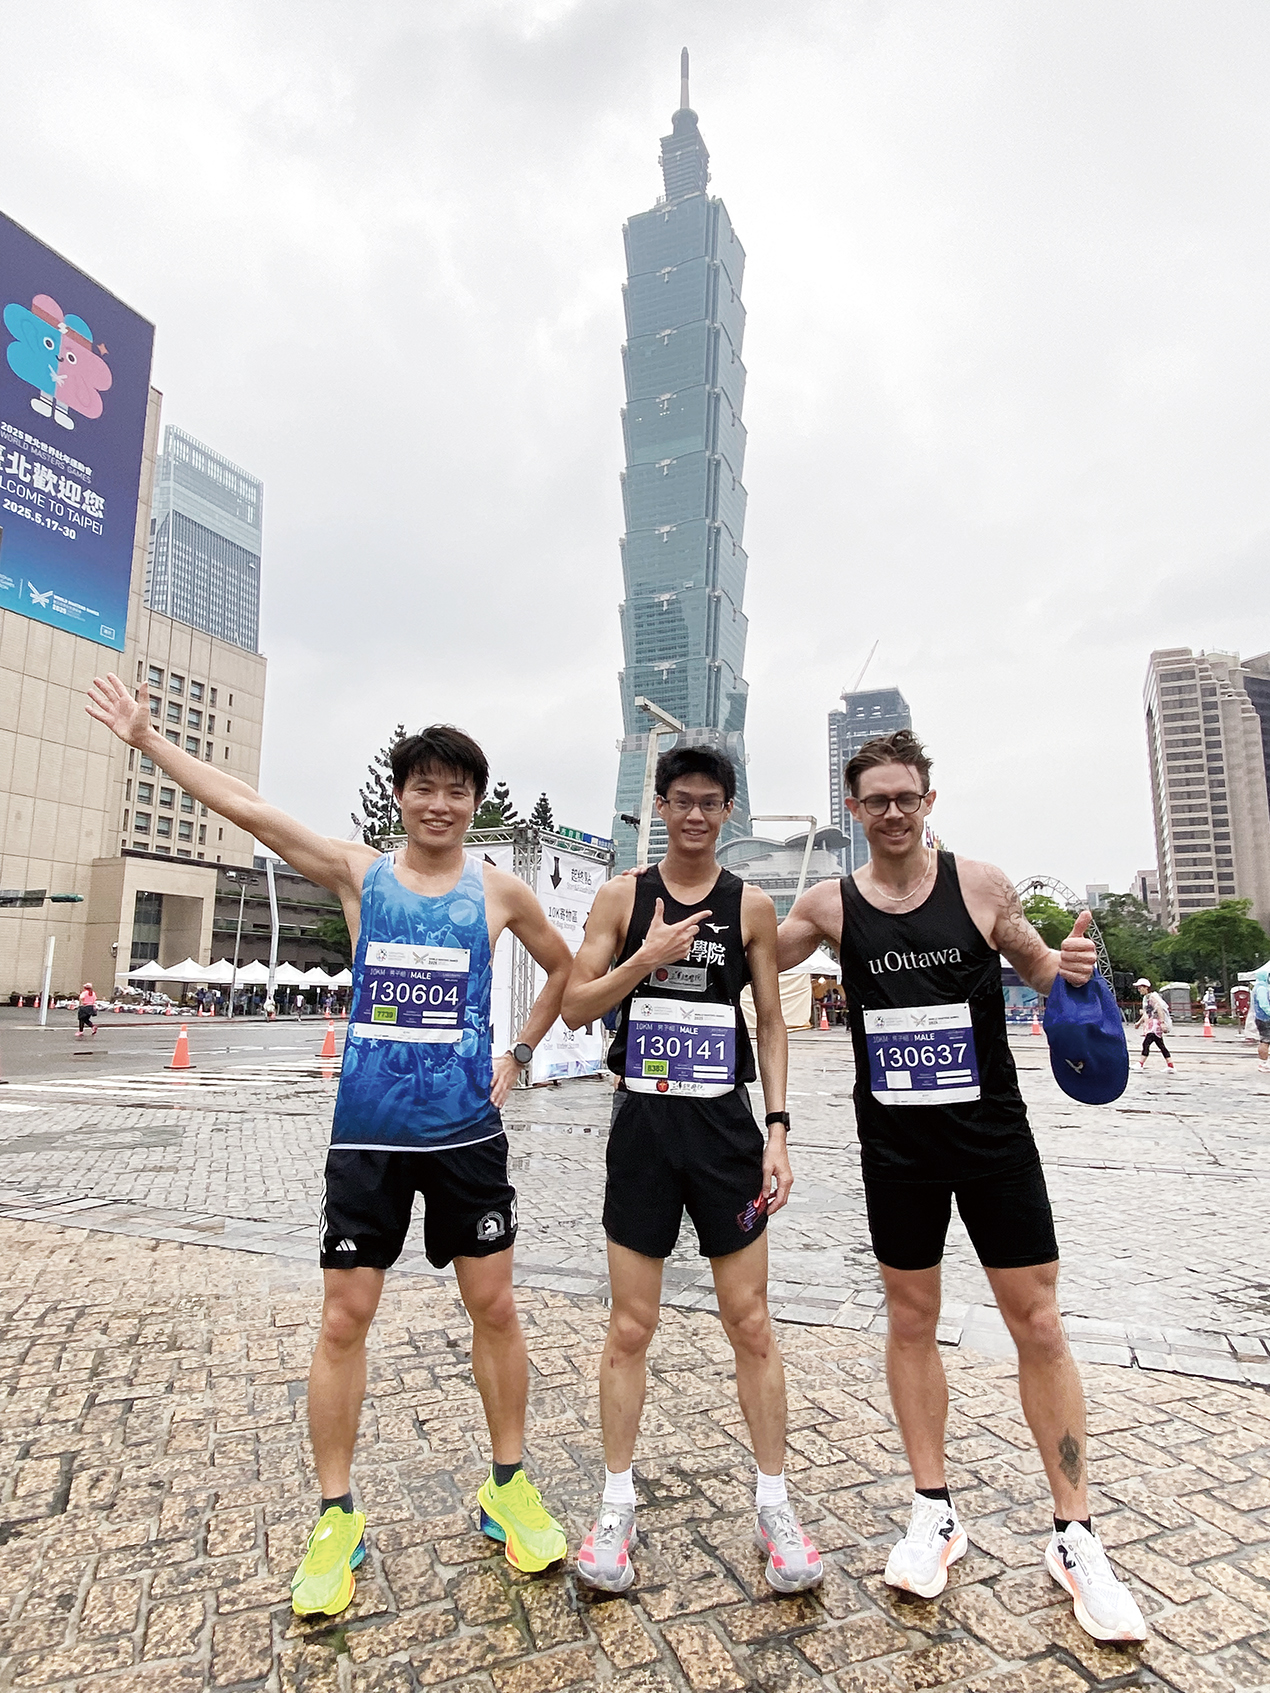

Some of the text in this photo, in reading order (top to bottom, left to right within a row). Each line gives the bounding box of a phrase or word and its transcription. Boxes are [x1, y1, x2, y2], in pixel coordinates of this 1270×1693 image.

[0, 430, 91, 484] WORLD MASTERS GAMES
[3, 498, 76, 540] 2025.5.17-30
[48, 498, 64, 516] TO
[67, 507, 103, 536] TAIPEI
[867, 946, 962, 975] uOttawa
[410, 971, 432, 980] MALE
[369, 980, 459, 1006] 130604
[679, 1026, 699, 1035] MALE
[914, 1032, 935, 1041] MALE
[636, 1034, 726, 1061] 130141
[875, 1042, 968, 1068] 130637
